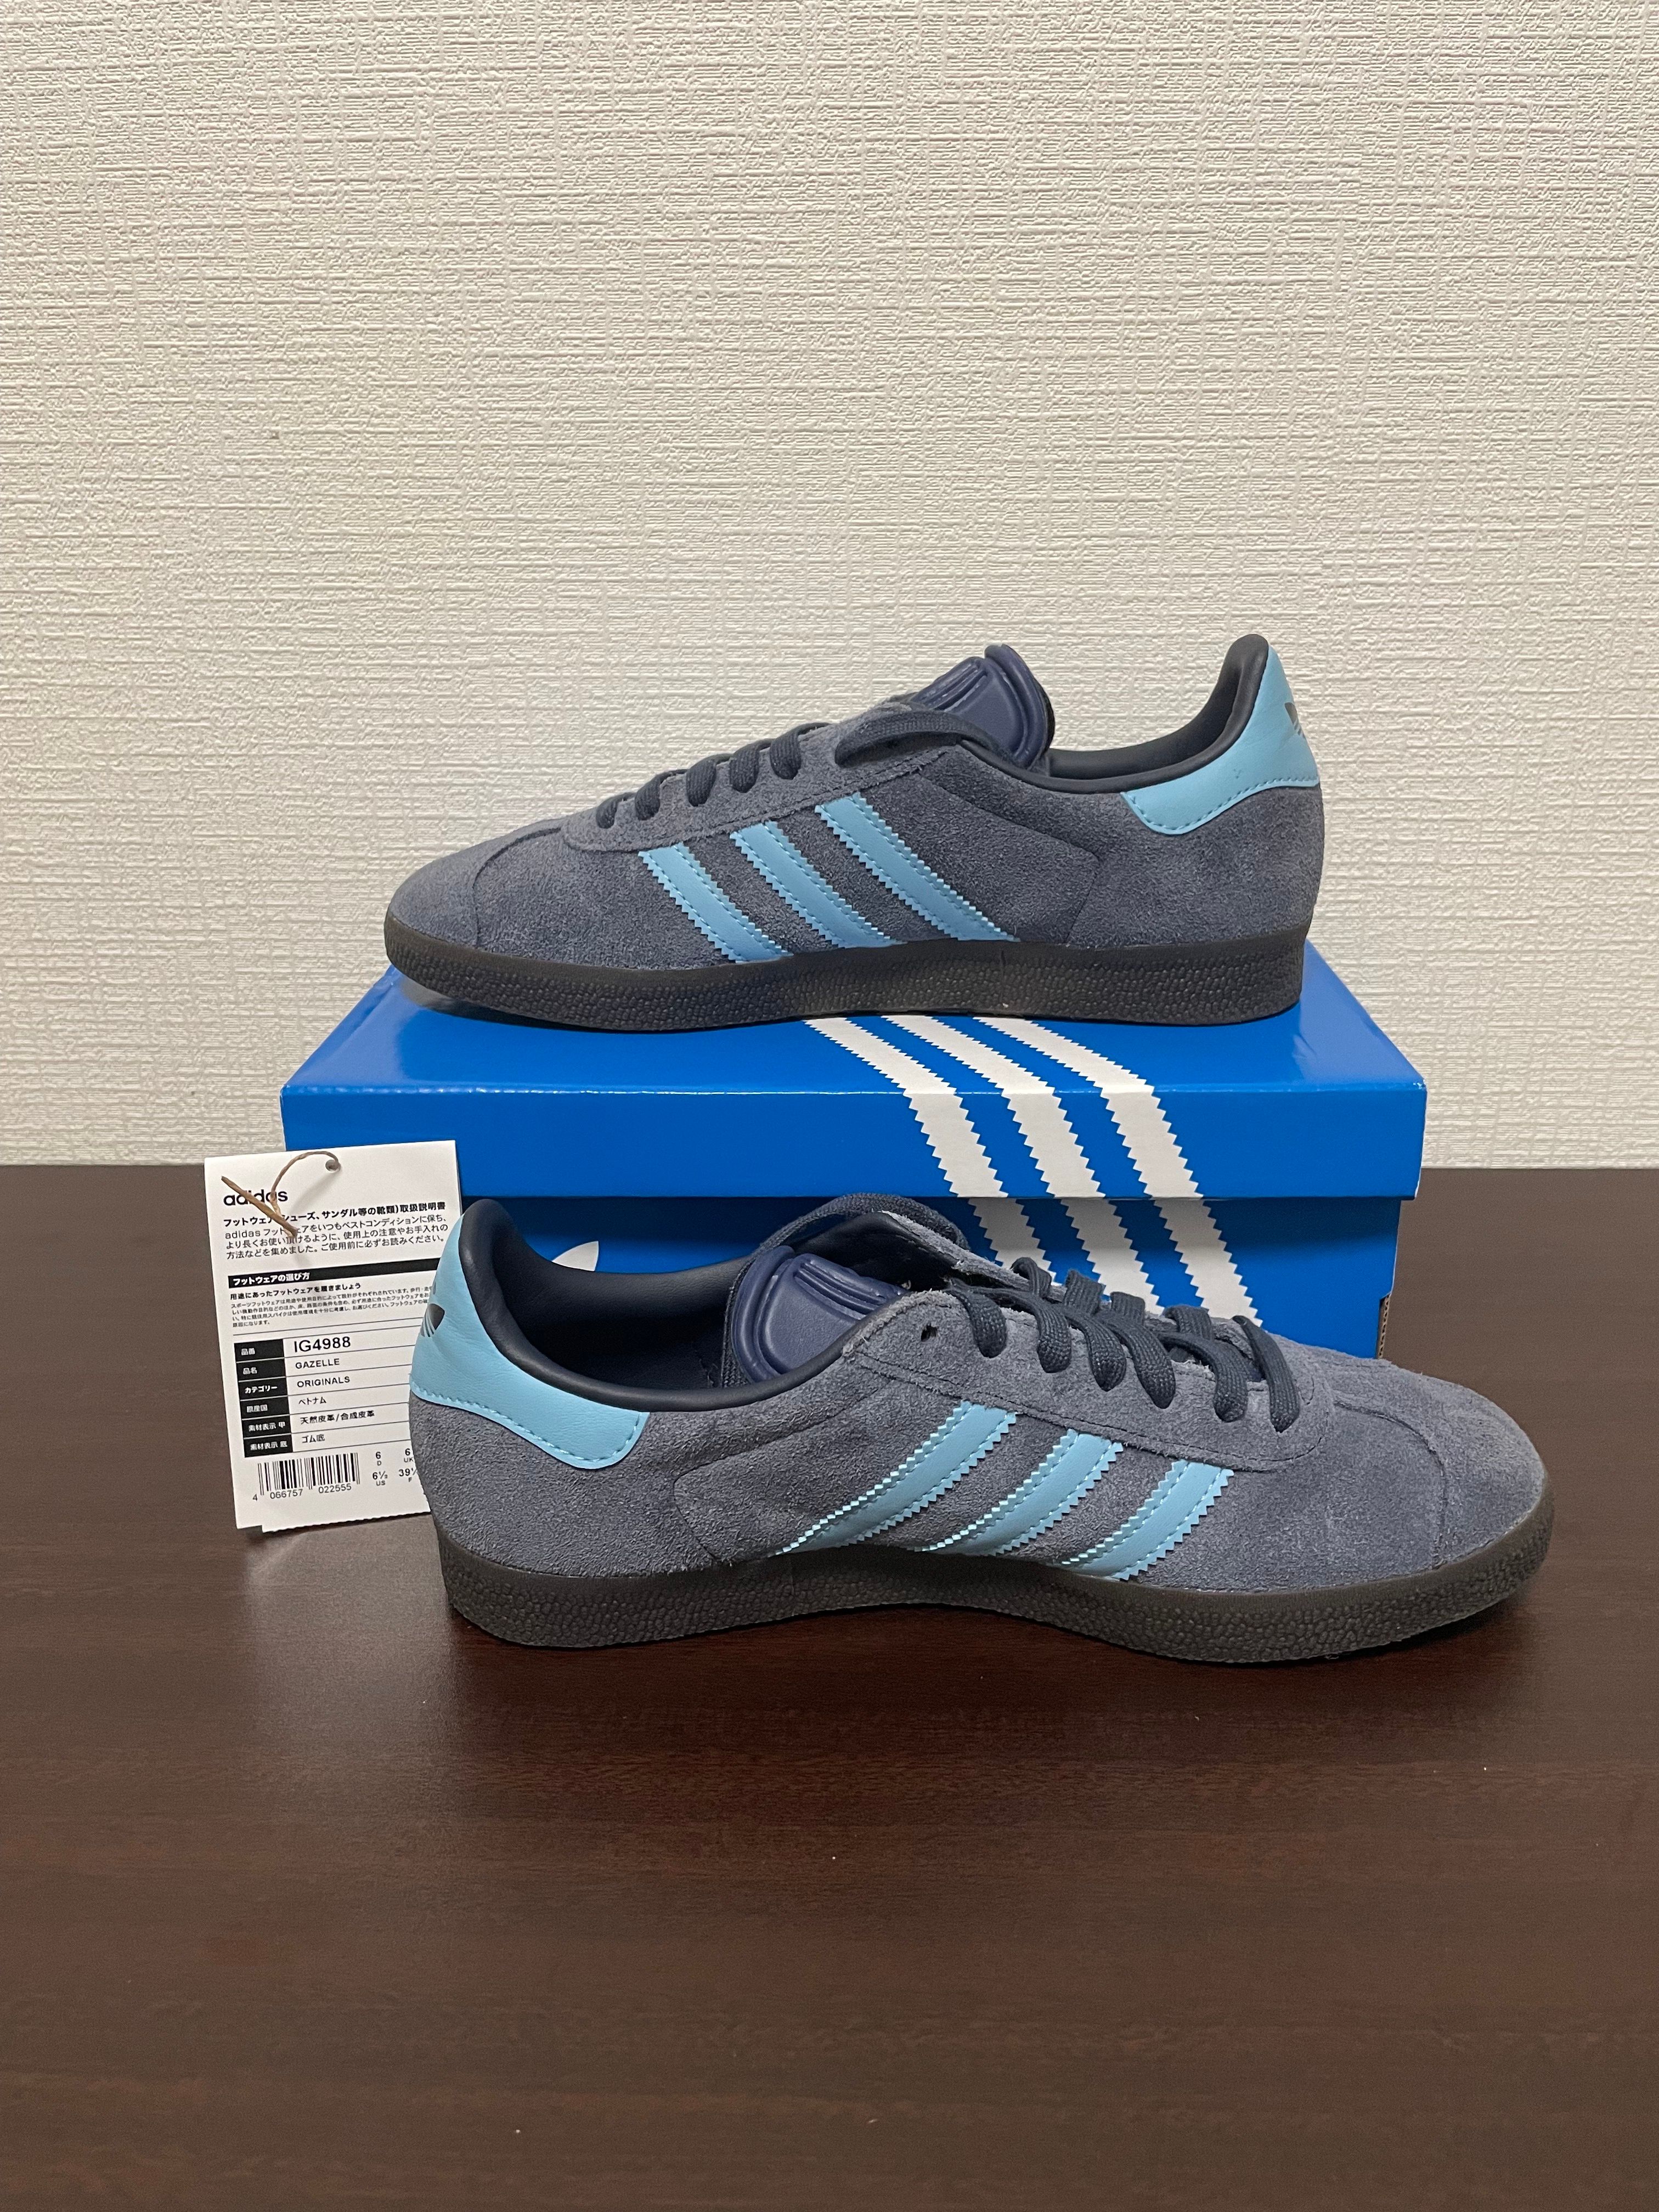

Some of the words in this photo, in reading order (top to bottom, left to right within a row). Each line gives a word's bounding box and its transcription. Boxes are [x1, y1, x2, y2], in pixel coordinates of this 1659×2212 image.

[225, 1229, 261, 1239] adidas
[233, 1272, 310, 1286] フットウェアの選び方
[294, 1336, 351, 1353] IG4988
[295, 1358, 340, 1369] GAZELLE
[297, 1376, 351, 1388] ORIGINALS
[245, 1385, 278, 1394] カテゴリー
[298, 1396, 327, 1406] ベトナム
[375, 1451, 381, 1459] 6
[405, 1448, 410, 1456] 6
[270, 1489, 303, 1499] 066757
[318, 1484, 352, 1493] 022555
